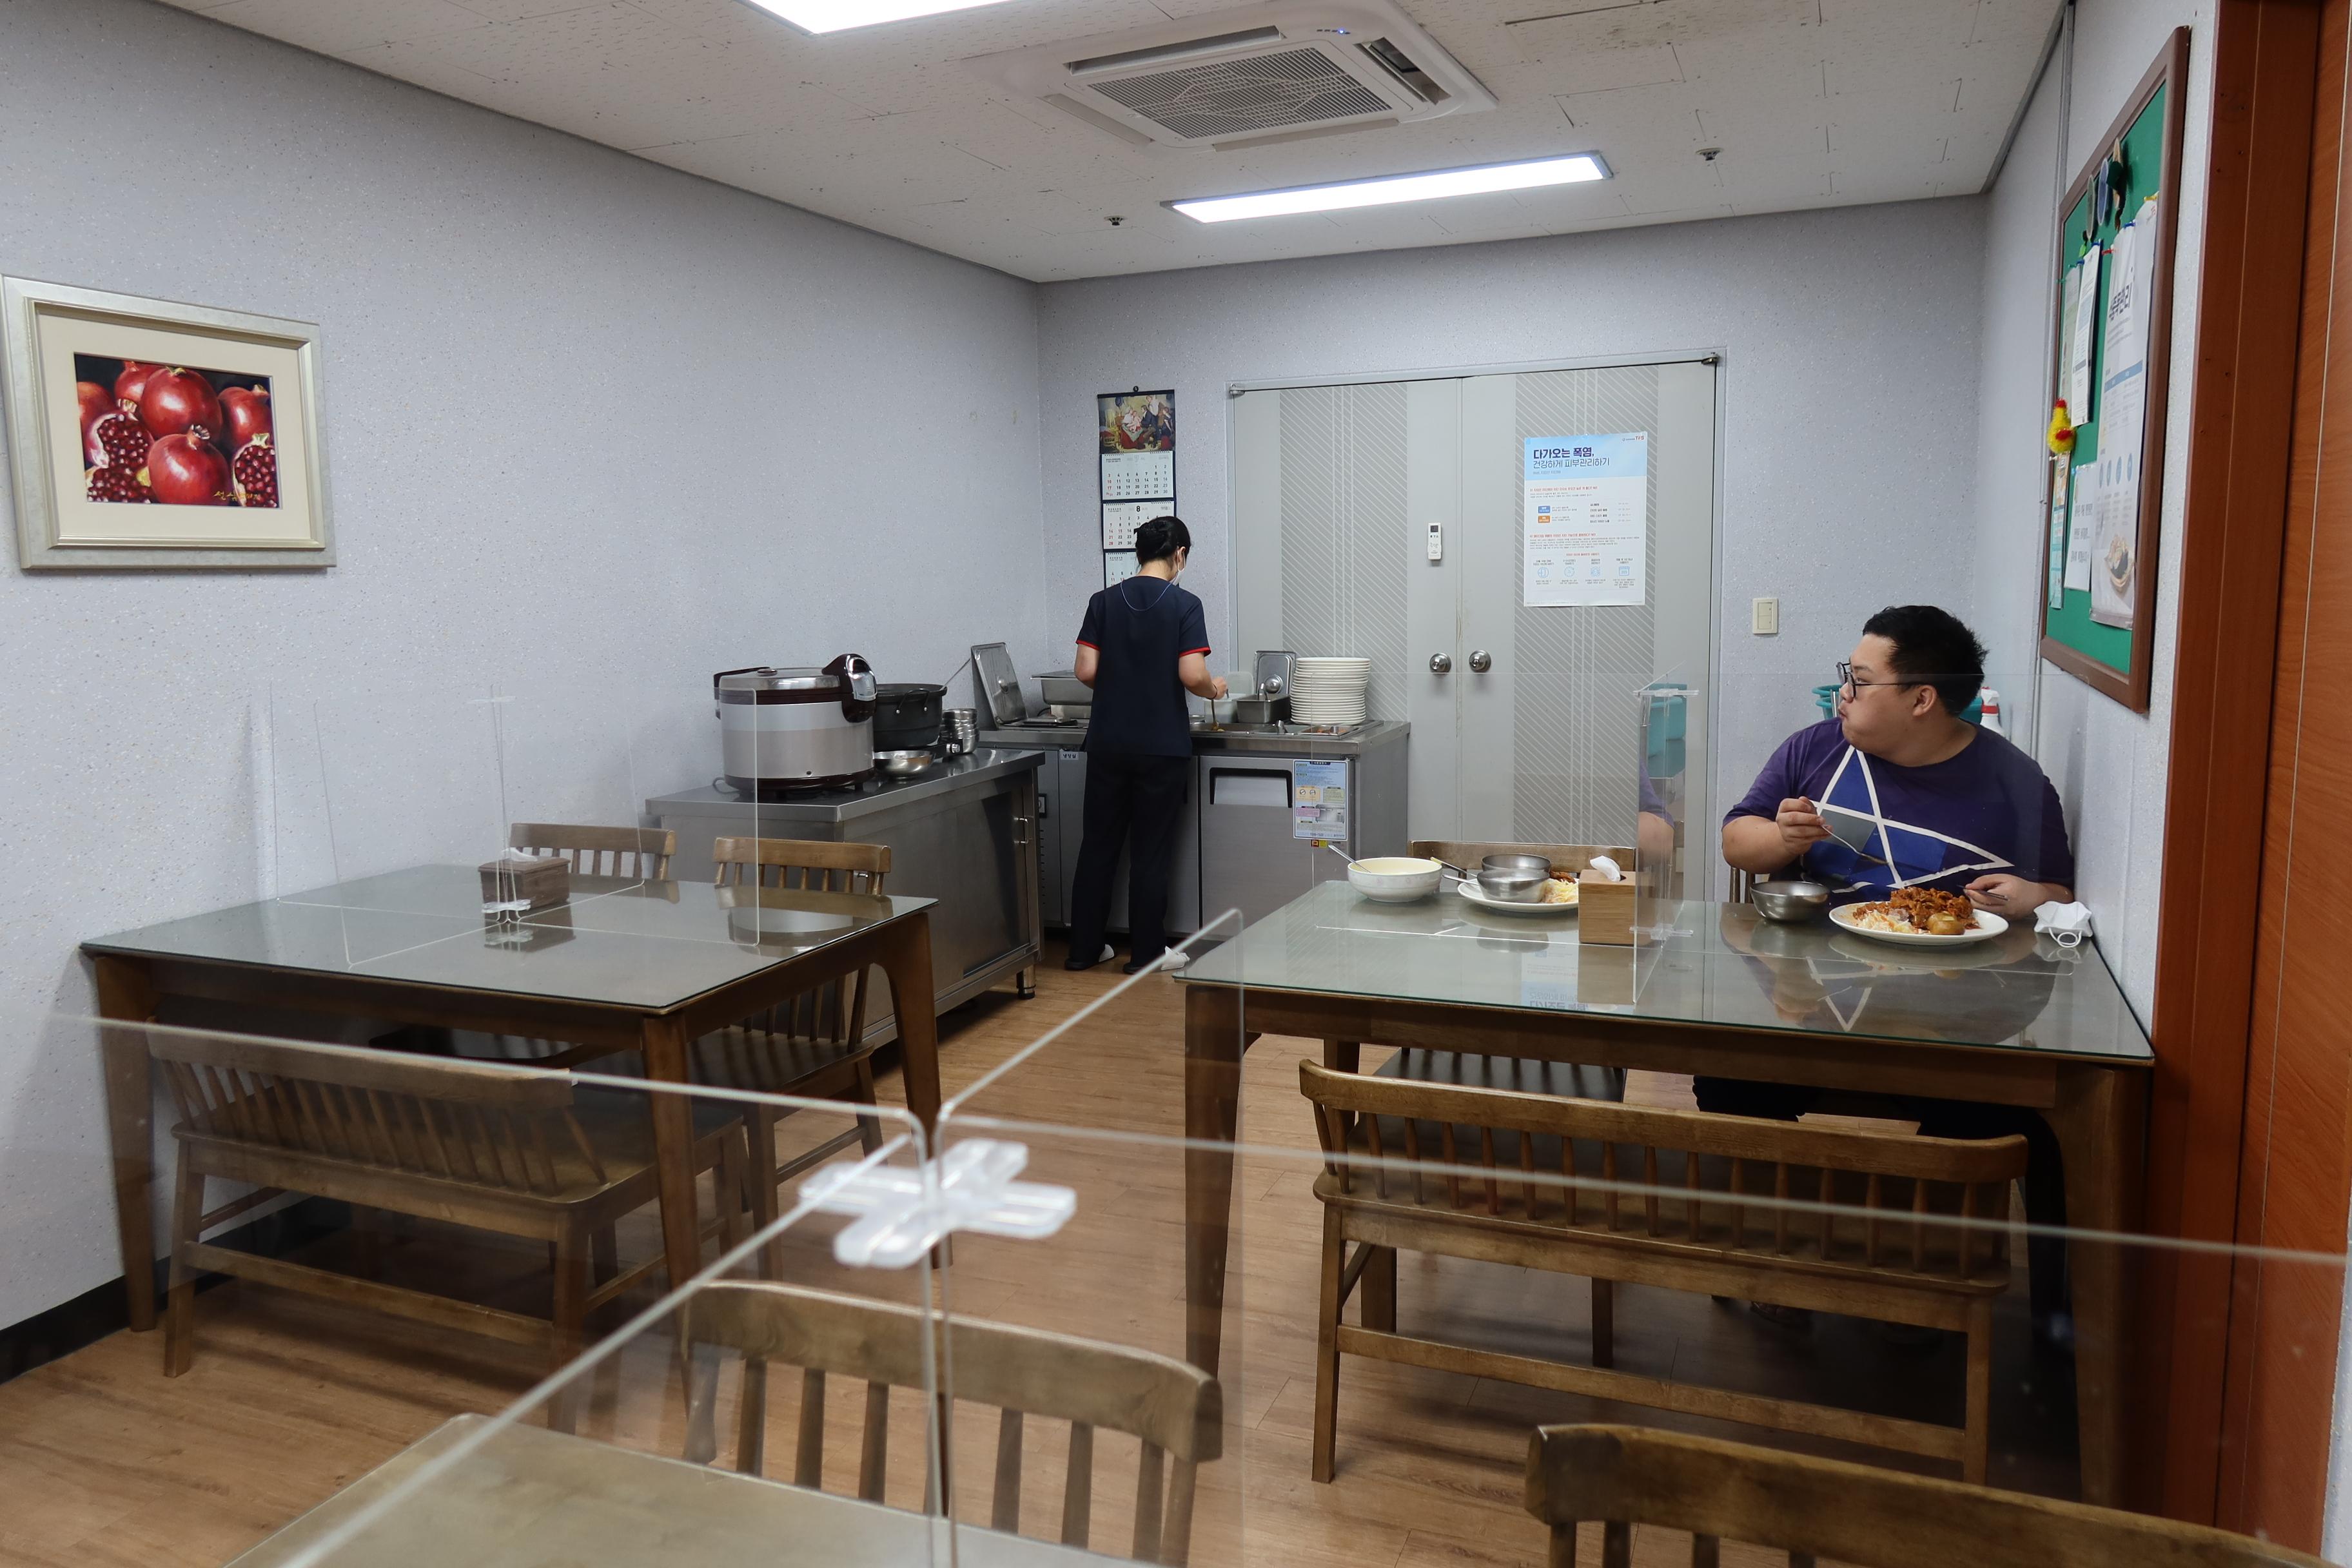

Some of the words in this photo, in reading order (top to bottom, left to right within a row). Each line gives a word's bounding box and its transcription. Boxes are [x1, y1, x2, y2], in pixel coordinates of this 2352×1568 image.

[1533, 449, 1571, 459] 다가오는
[1573, 447, 1594, 457] 폭염,
[1533, 459, 1563, 469] 건강하게
[1564, 457, 1610, 468] 피부관리하기
